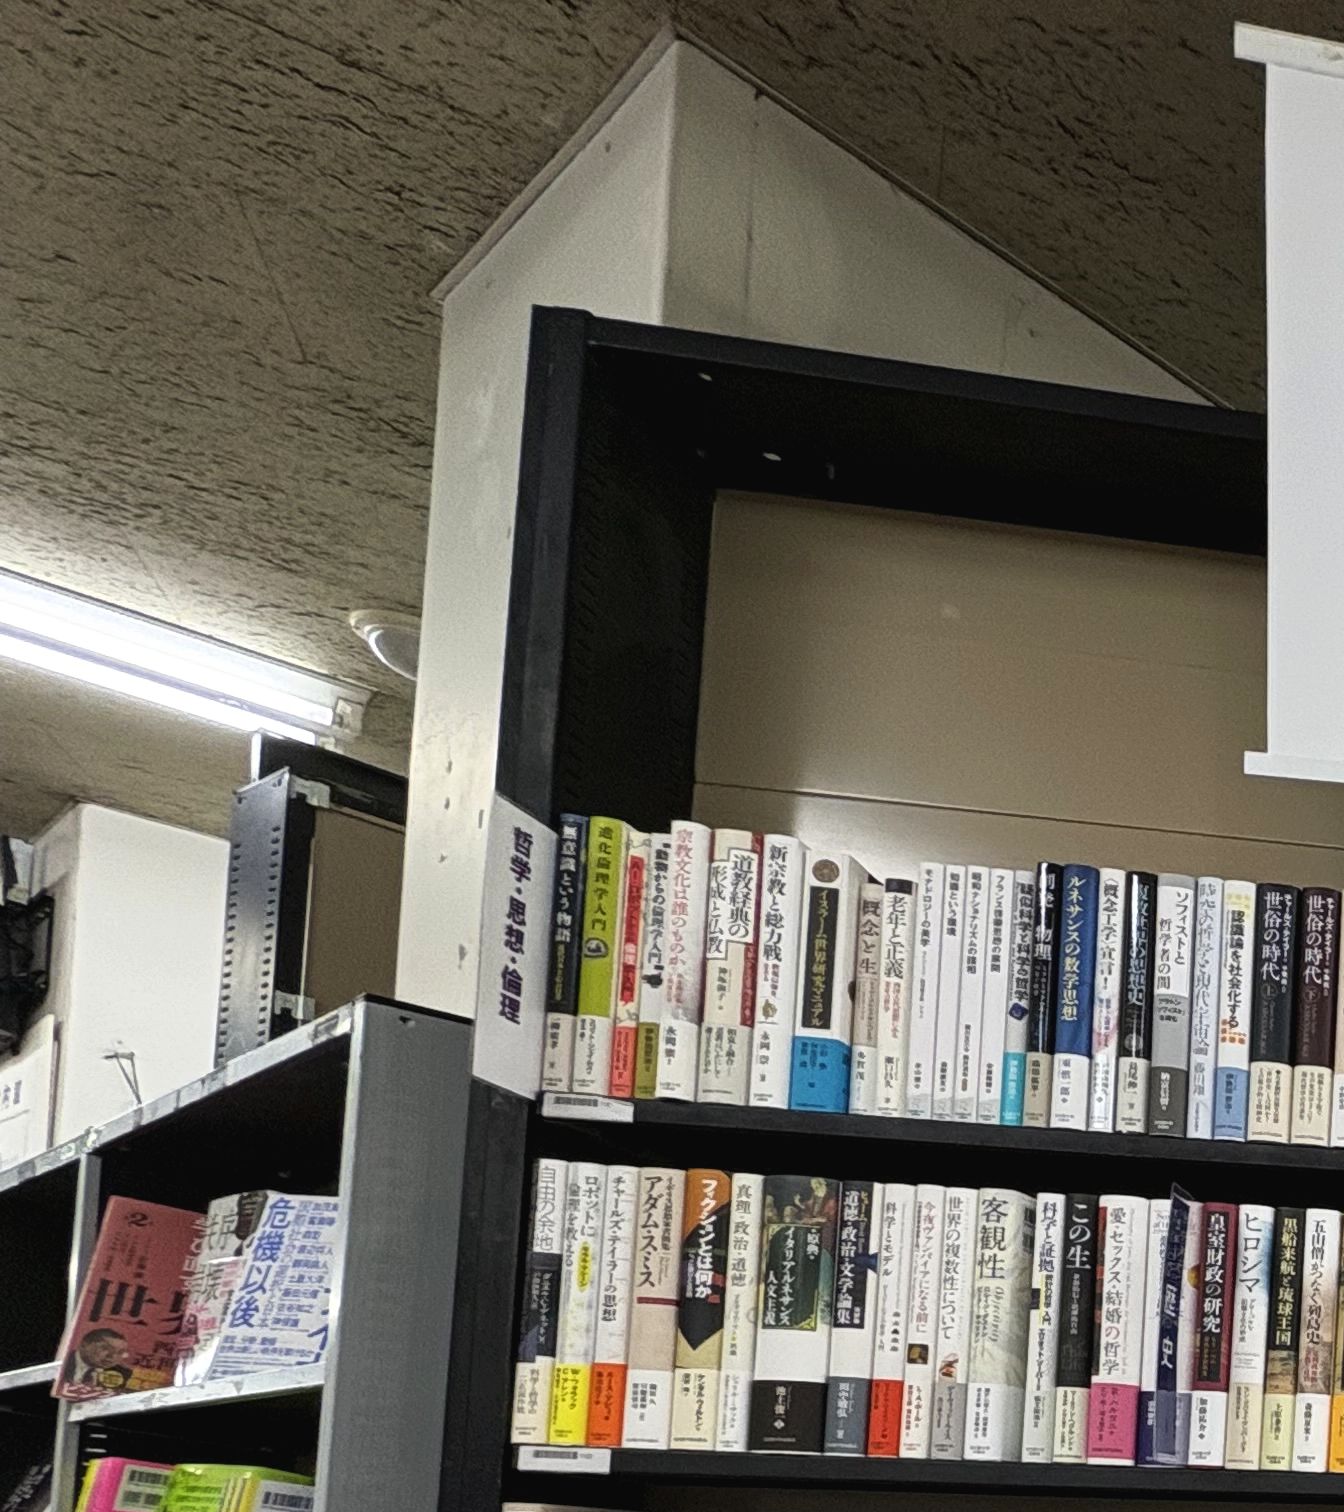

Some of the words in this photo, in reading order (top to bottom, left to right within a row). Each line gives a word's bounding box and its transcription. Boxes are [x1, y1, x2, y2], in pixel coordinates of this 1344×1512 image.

[499, 826, 533, 1025] 哲学・思想・倫理
[708, 864, 725, 956] 形成と仏教
[729, 853, 755, 939] 道教経典の
[764, 843, 788, 963] 新宗教と総力戦
[884, 894, 906, 979] 老年と正義
[1262, 893, 1283, 982] 世俗の時代
[1304, 893, 1324, 985] 世俗の時代
[1060, 874, 1086, 1021] ルネサンスの数学思想
[229, 1197, 294, 1328] 危機以後
[636, 1176, 663, 1287] アダム・スミス
[692, 1178, 719, 1300] フィクションとは何か
[940, 1196, 964, 1340] 世界の複数性について
[976, 1197, 1007, 1281] 客観性
[1037, 1202, 1057, 1273] 科学と証拠
[1065, 1203, 1092, 1270] この生
[1203, 1212, 1230, 1334] 皇室財政の研究
[1238, 1212, 1261, 1294] ヒロシマ
